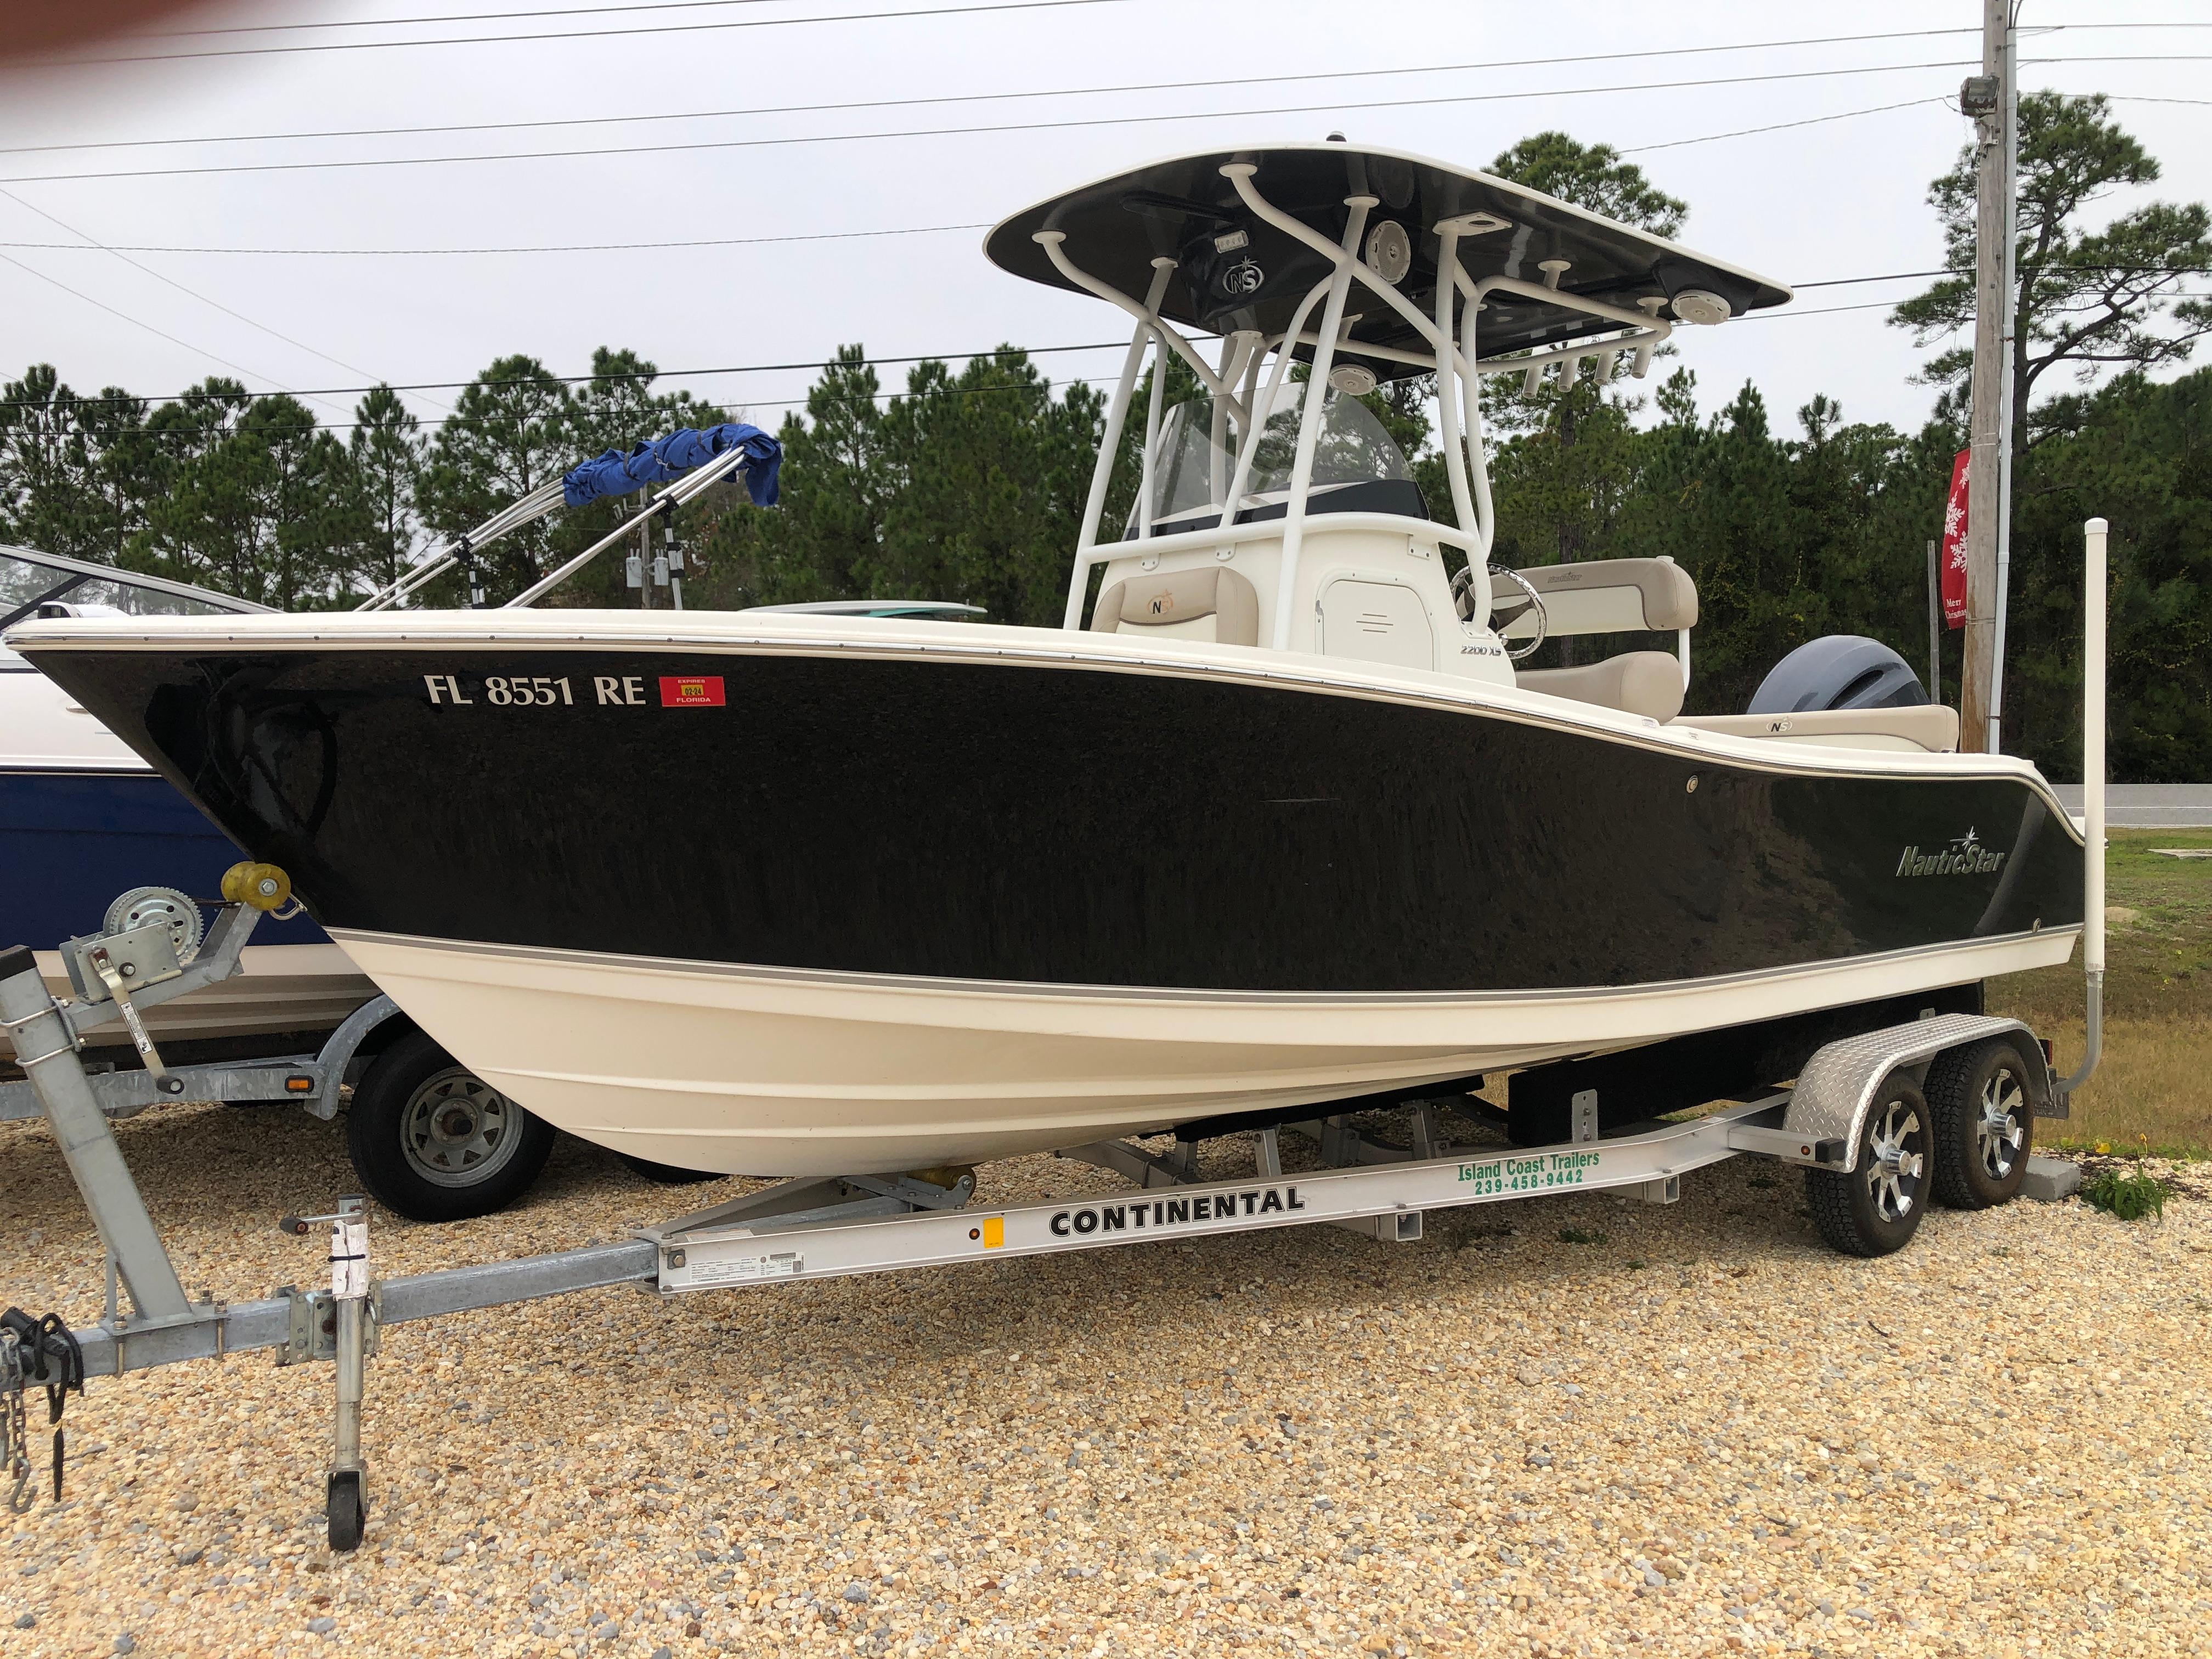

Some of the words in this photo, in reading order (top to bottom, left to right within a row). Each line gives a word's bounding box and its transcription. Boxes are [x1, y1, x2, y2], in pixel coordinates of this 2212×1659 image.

[1231, 270, 1256, 293] NS
[1460, 645, 1487, 655] 2200
[424, 675, 473, 704] FL
[485, 676, 573, 706] 8551
[594, 676, 646, 705] RE
[1771, 722, 1788, 732] NS
[1895, 844, 2006, 877] NauticStar
[1458, 1160, 1500, 1181] Island
[1506, 1156, 1545, 1176] Coast
[1550, 1152, 1600, 1170] Trailers
[1475, 1169, 1583, 1195] 239-458-9442
[1048, 1186, 1305, 1238] CONTINENTAL
